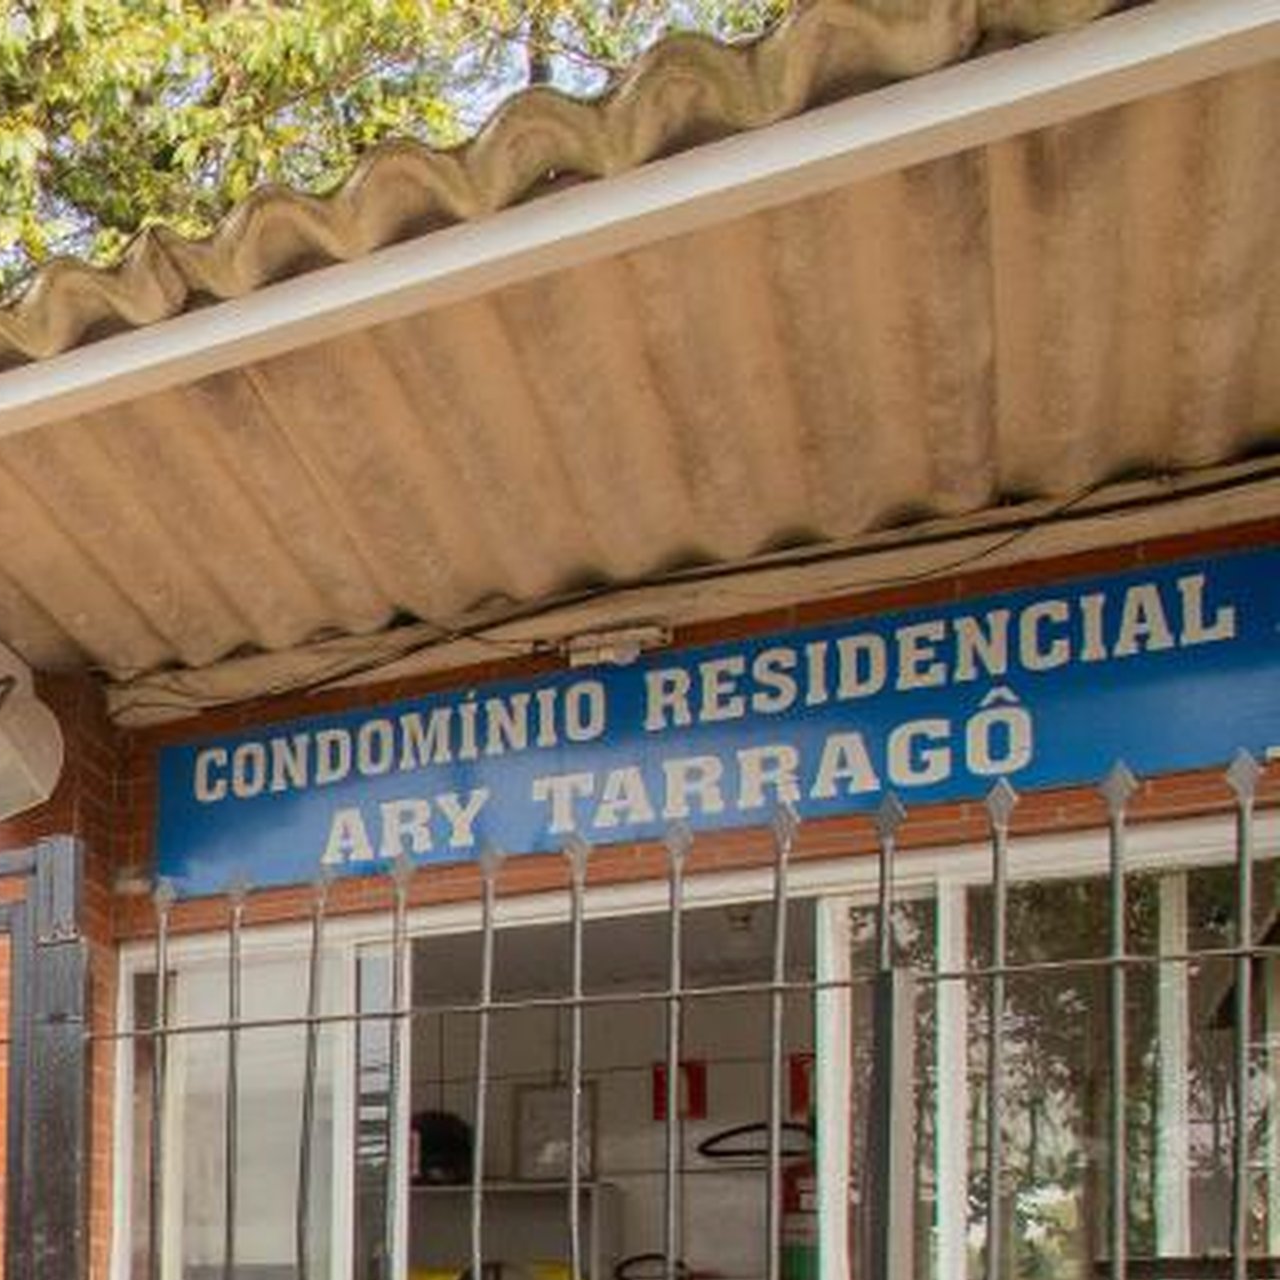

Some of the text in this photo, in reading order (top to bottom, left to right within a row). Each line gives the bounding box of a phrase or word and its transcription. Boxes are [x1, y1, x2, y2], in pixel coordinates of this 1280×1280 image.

[194, 574, 1238, 804] CONDOMÍNIO RESIDENCIAL
[320, 686, 1037, 866] ARY TARRAGÔ
